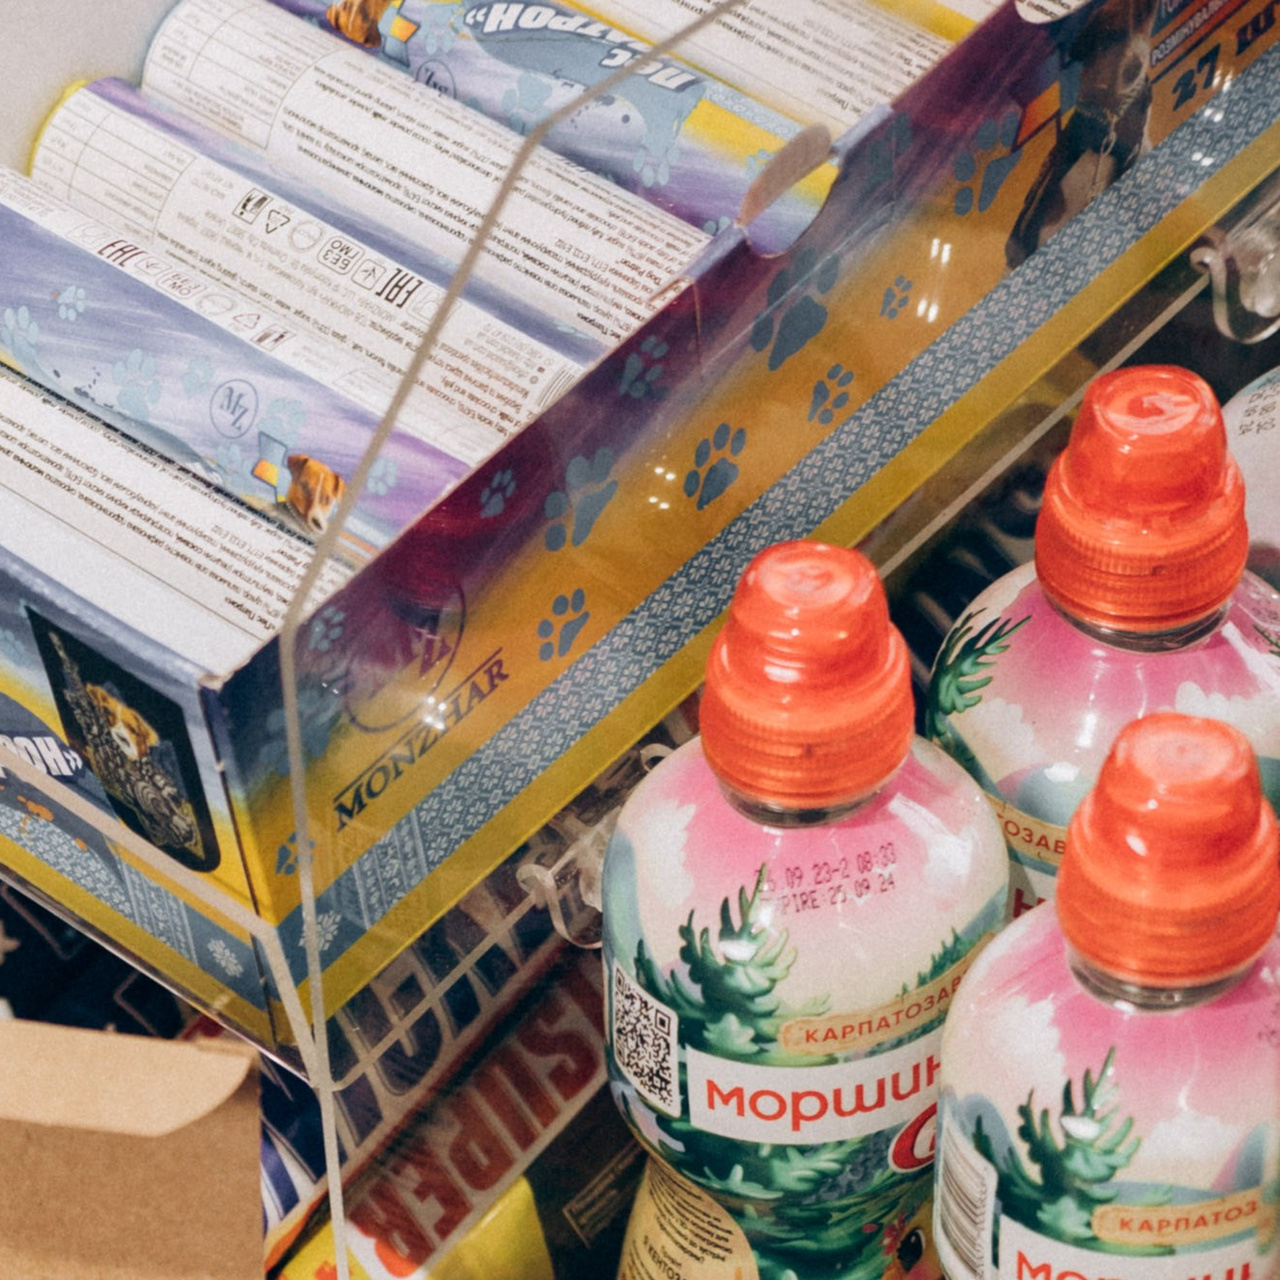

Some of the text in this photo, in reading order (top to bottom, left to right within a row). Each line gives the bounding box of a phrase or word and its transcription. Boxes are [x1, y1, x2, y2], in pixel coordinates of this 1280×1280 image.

[324, 250, 348, 269] БЕЗ
[331, 239, 357, 258] ГМО
[333, 652, 510, 831] MONZHAR
[804, 970, 970, 1044] КАРПАТОЗАВ
[1118, 1198, 1257, 1235] КАРПАТОЗ
